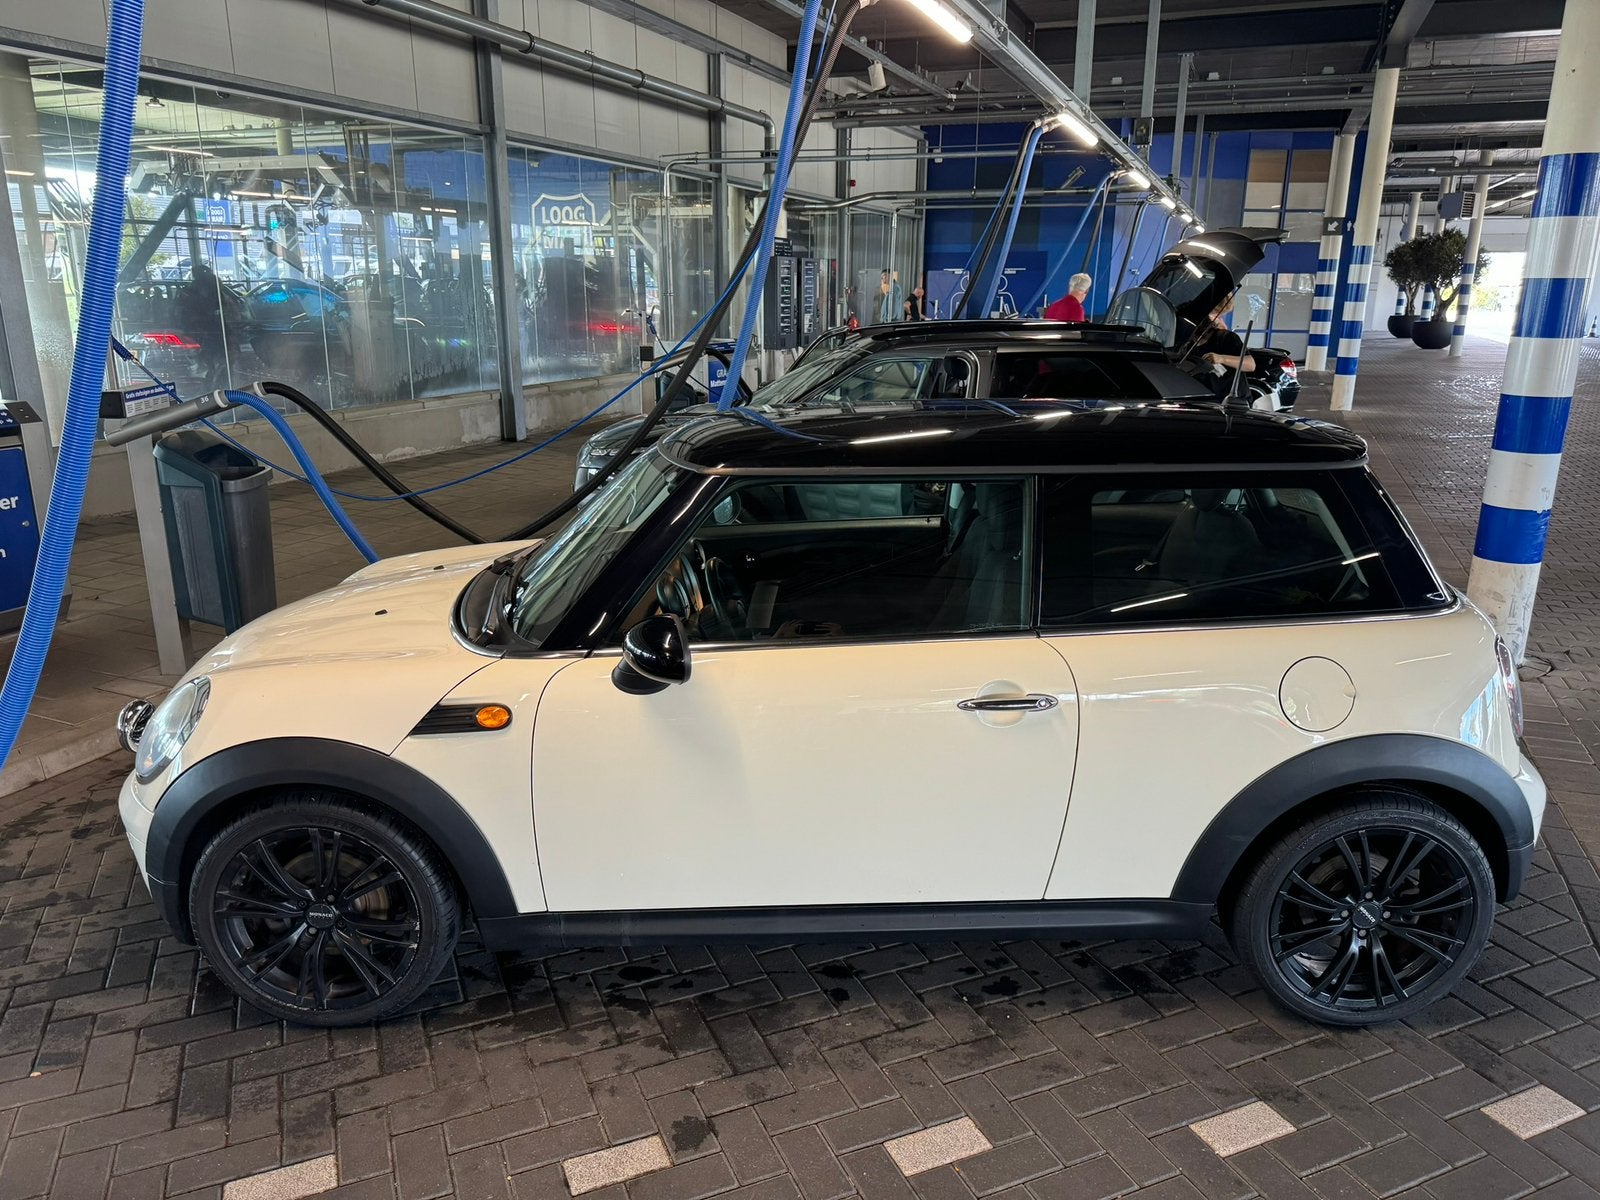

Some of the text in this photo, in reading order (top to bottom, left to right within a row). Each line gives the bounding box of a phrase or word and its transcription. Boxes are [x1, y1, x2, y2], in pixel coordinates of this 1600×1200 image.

[541, 205, 585, 224] LOOG
[200, 395, 209, 404] 36
[0, 496, 18, 510] er
